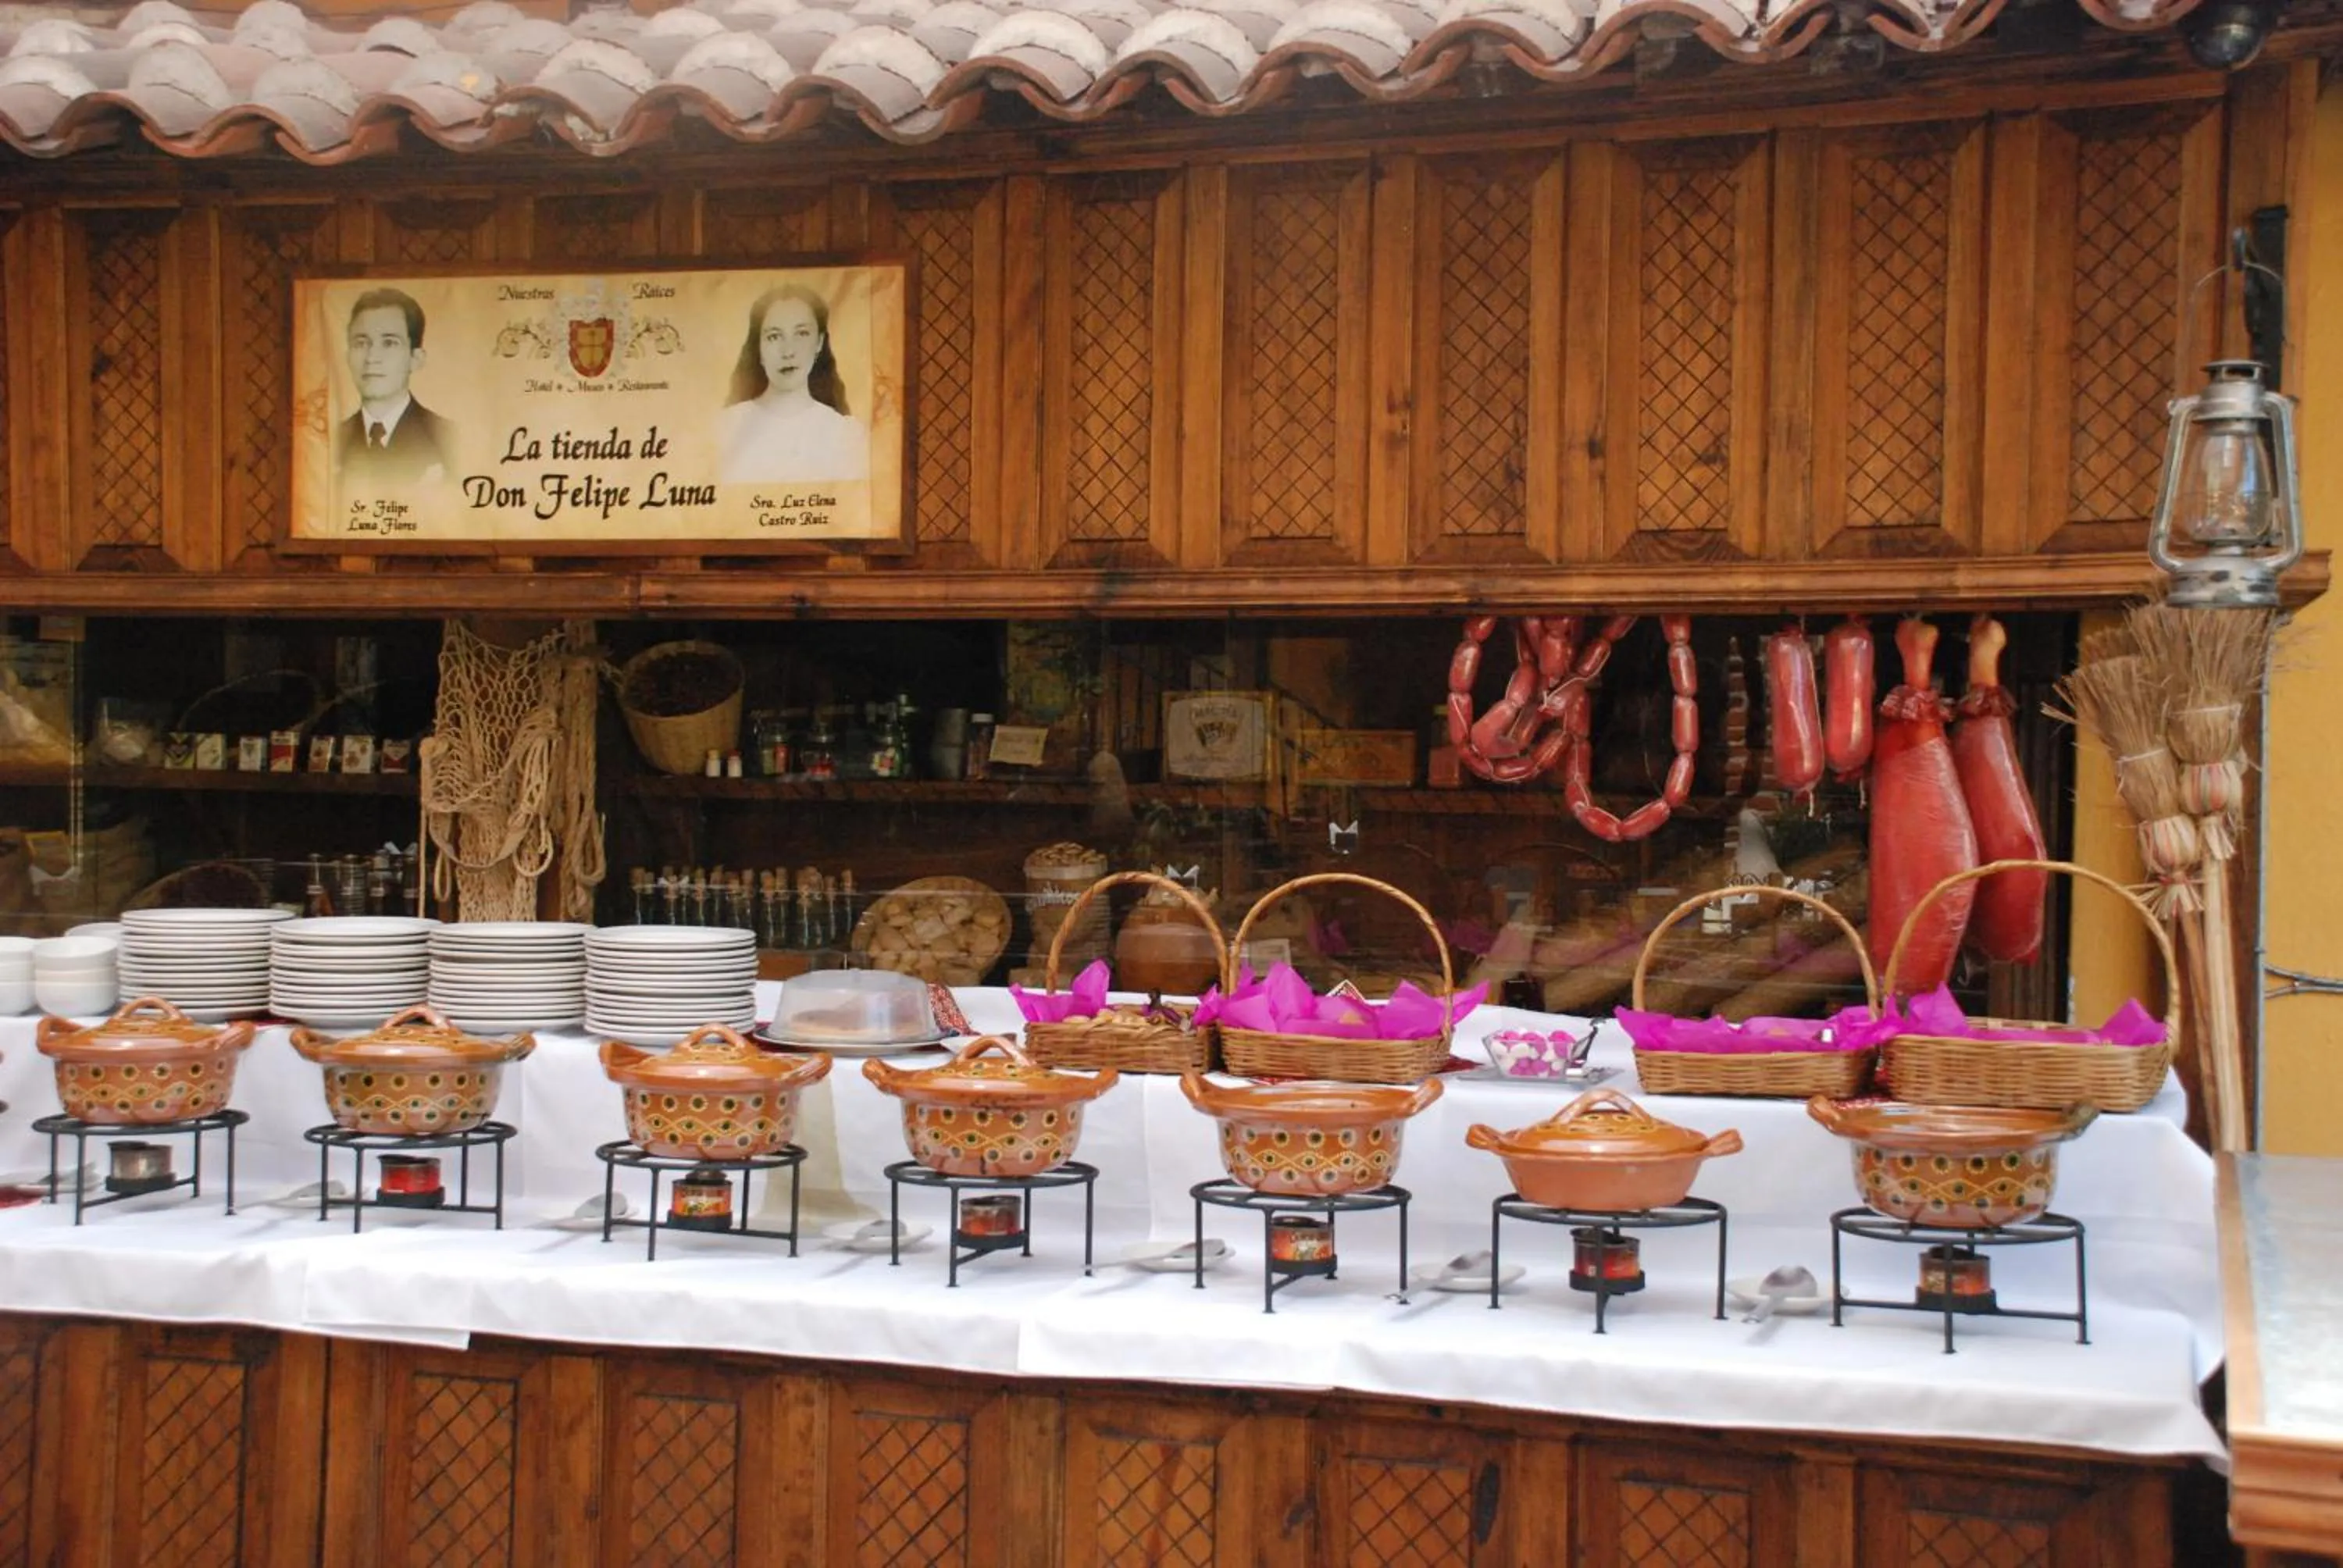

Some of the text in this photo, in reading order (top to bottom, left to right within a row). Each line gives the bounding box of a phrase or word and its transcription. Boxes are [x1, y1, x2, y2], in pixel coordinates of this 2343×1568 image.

[500, 426, 669, 465] La tienda de
[462, 472, 717, 520] Don Felipe Luna
[750, 494, 837, 509] Sra. Luz Elena
[373, 500, 408, 517] Felipe
[347, 517, 378, 532] Luna
[758, 511, 830, 526] Castro Ruiz
